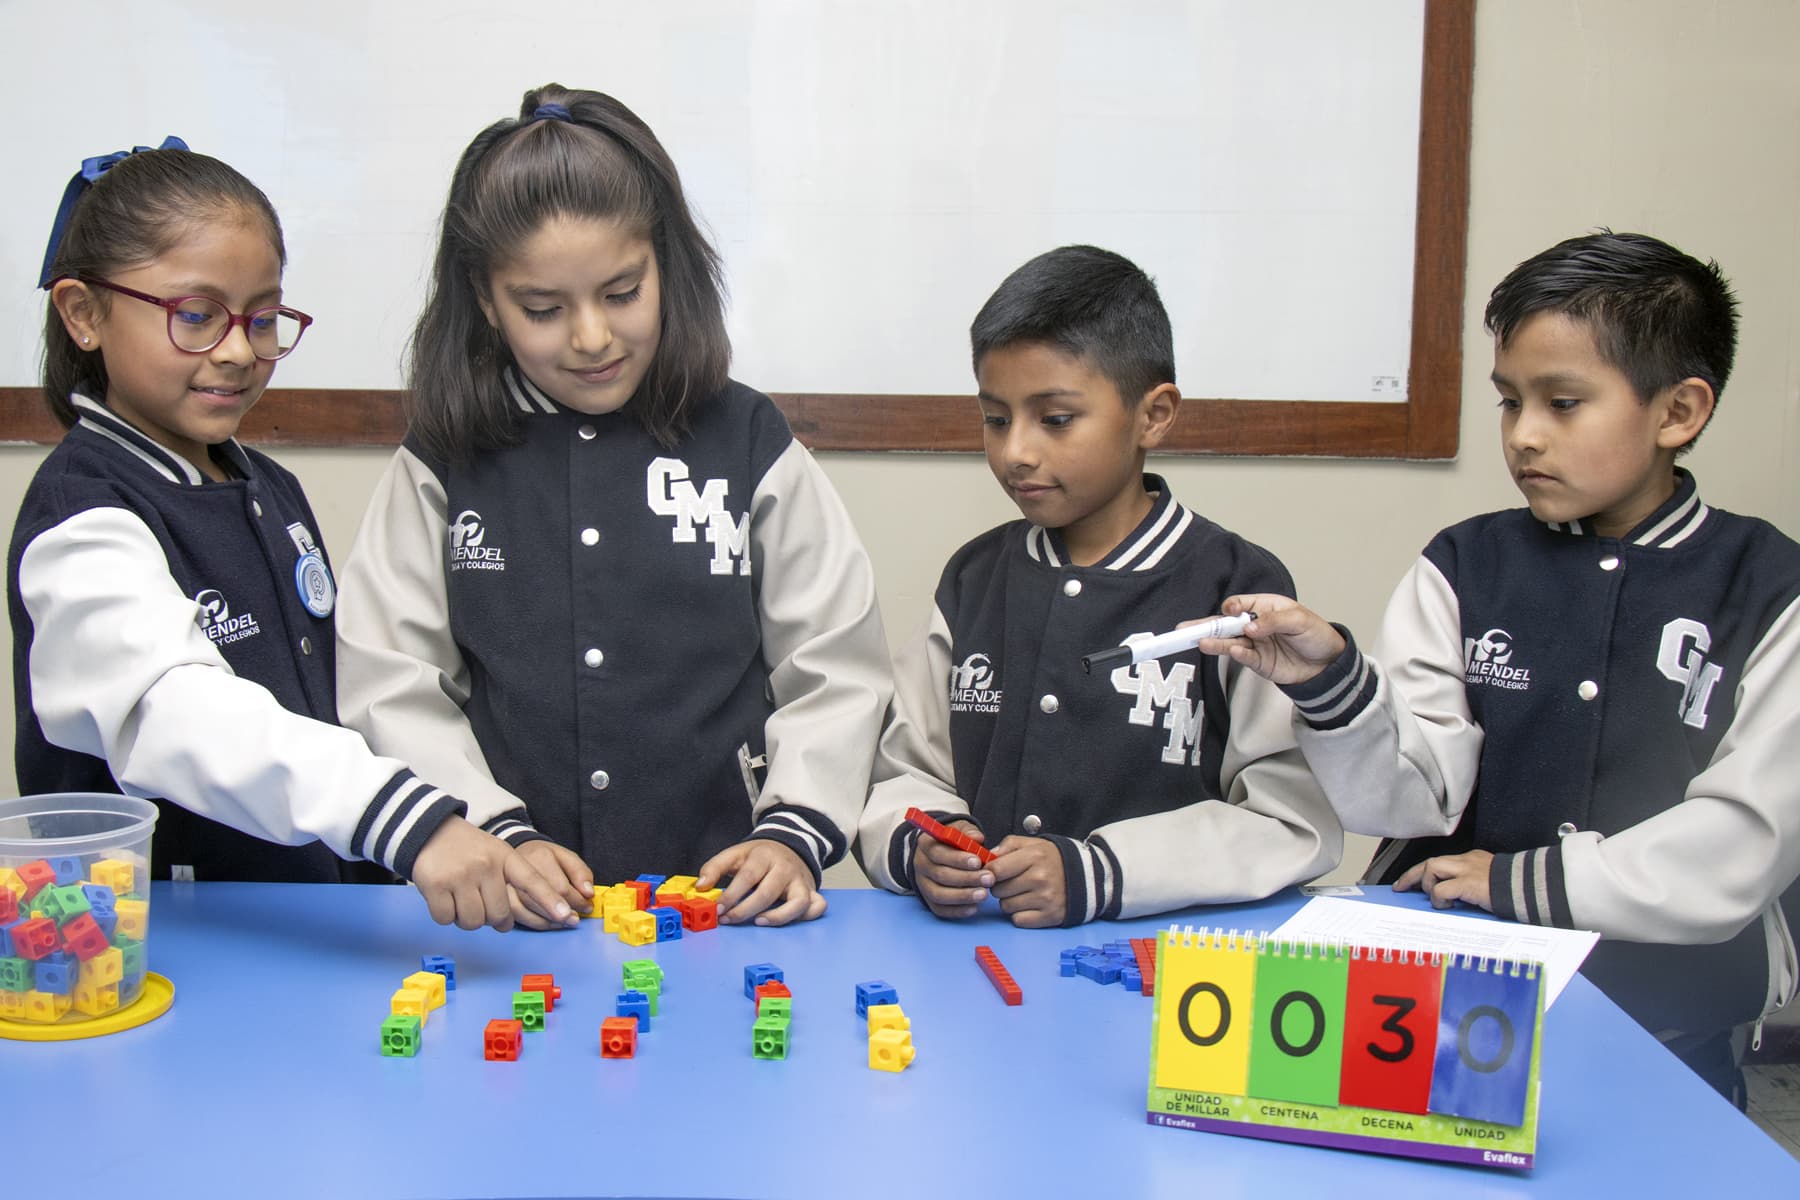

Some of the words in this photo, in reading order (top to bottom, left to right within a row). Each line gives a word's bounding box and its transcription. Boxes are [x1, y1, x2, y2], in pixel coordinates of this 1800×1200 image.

[1468, 660, 1531, 681] MENDEL
[1491, 678, 1529, 690] COLEGIOS
[950, 689, 1003, 703] MENDE
[974, 703, 1000, 713] COLEG
[1178, 982, 1231, 1047] 0
[1271, 990, 1326, 1057] 0
[1367, 994, 1416, 1062] 3
[1456, 1005, 1515, 1073] 0
[1174, 1092, 1222, 1105] UNIDAD
[1166, 1101, 1182, 1111] DE
[1185, 1103, 1230, 1116] MILLAR
[1260, 1106, 1319, 1120] CENTENA
[1166, 1117, 1196, 1128] Evaflex
[1361, 1116, 1414, 1131] DECENA
[1454, 1126, 1506, 1140] UNIDAD
[1483, 1151, 1526, 1165] Evaflex
